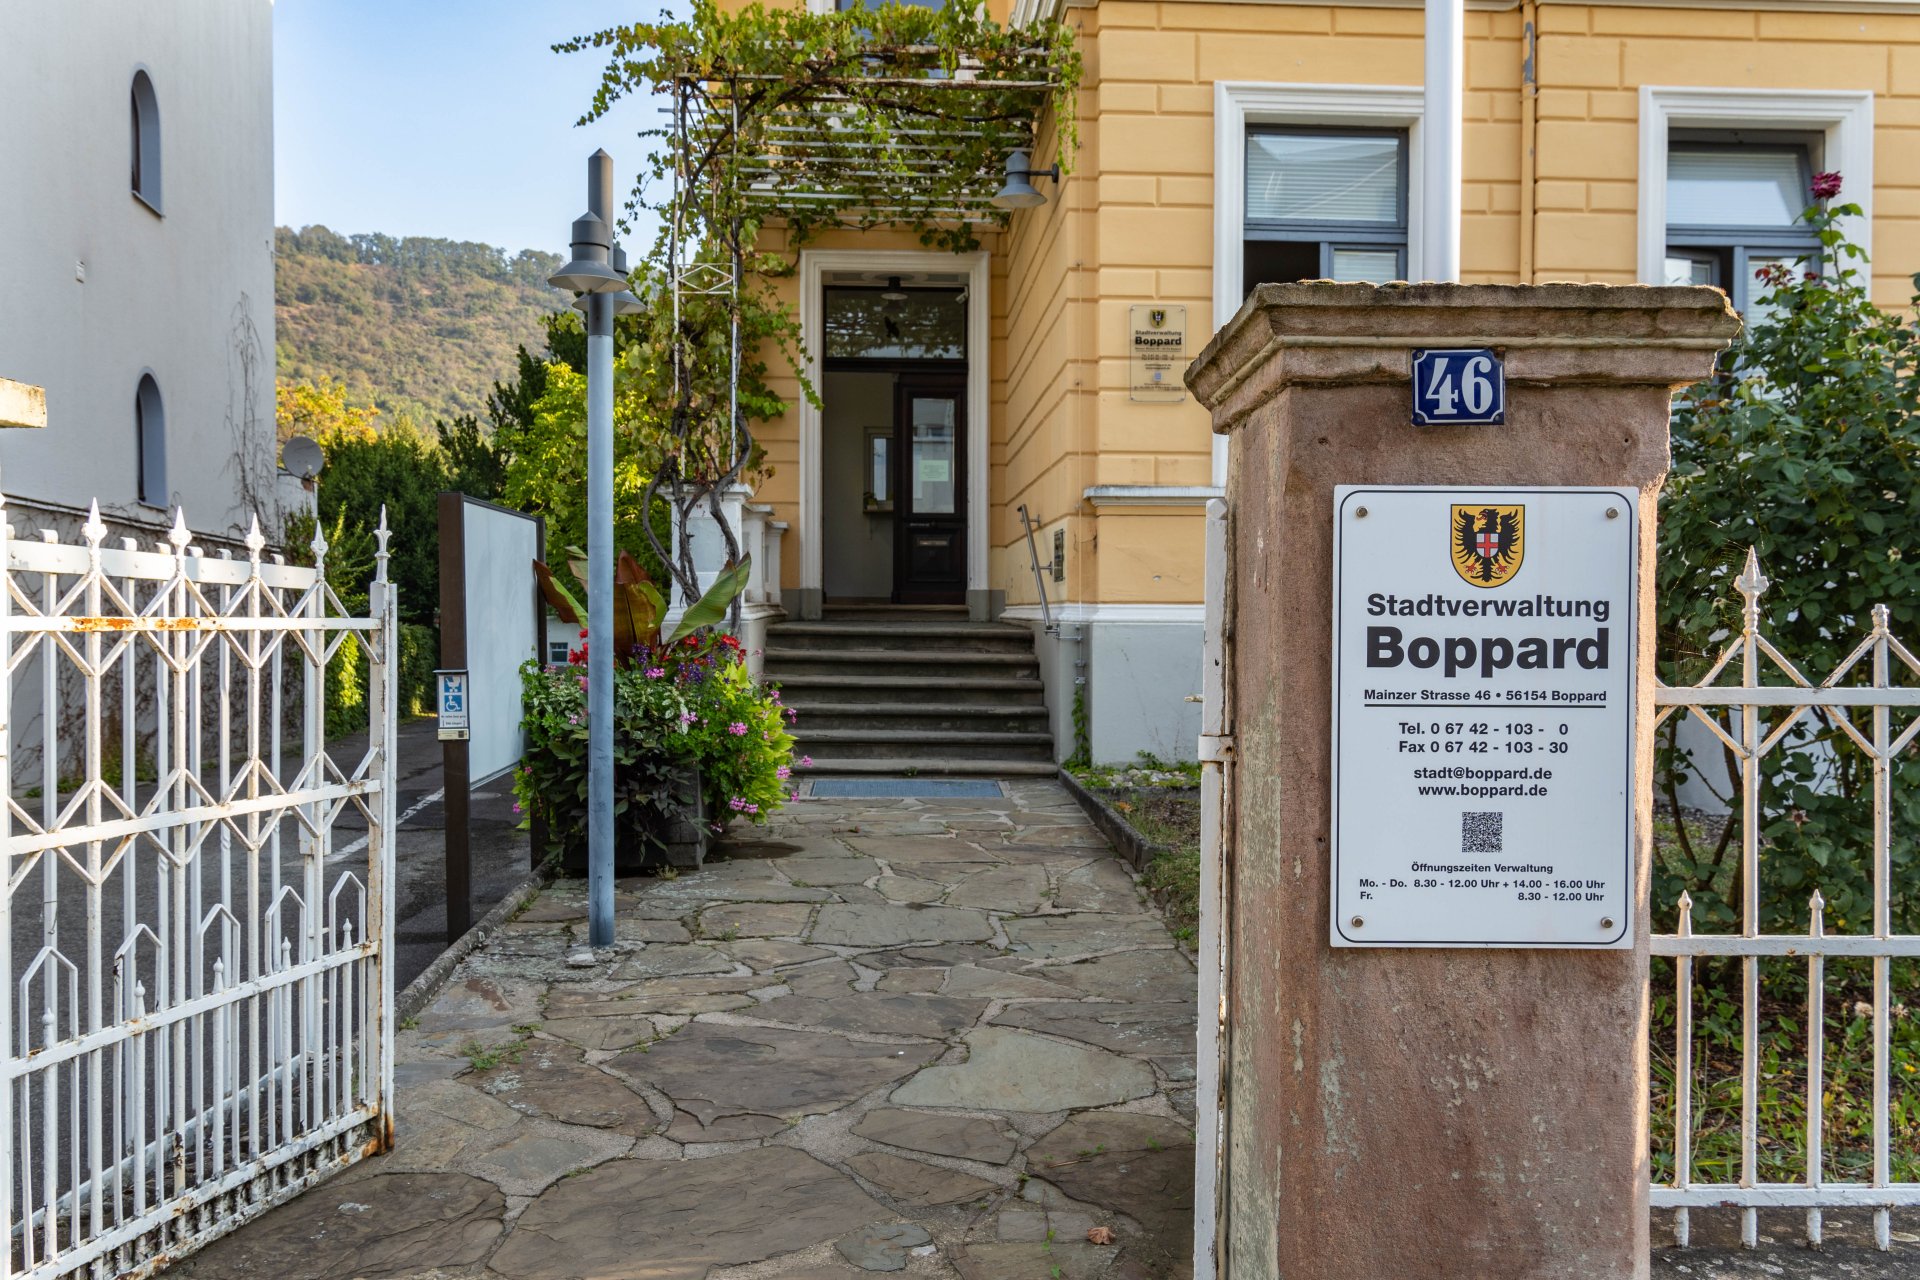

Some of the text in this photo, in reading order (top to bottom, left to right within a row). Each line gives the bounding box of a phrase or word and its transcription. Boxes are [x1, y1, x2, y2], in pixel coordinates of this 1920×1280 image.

[1135, 336, 1182, 347] Boppard
[1425, 356, 1493, 415] 46
[1367, 593, 1609, 622] Stadtverwaltung
[1367, 626, 1609, 678] Boppard
[1365, 690, 1606, 703] Mainzer Strasse 46 56154 Boppard
[1399, 723, 1425, 734] Tel.
[1431, 723, 1439, 734] 0
[1445, 723, 1463, 734] 67
[1469, 723, 1488, 734] 42
[1506, 723, 1534, 735] 103
[1559, 724, 1568, 735] 0
[1400, 741, 1425, 752] Fax
[1431, 741, 1439, 752] 0
[1445, 741, 1463, 752] 67
[1469, 742, 1487, 753] 42
[1506, 742, 1533, 753] 103
[1549, 742, 1568, 753] 30
[1414, 767, 1552, 781] stadt@boppard.de
[1418, 784, 1547, 798] www.boppard.de
[1412, 862, 1553, 874] Öffnungszeiten Verwaltung
[1360, 879, 1378, 887] Mo.
[1390, 879, 1407, 887] Do.
[1481, 880, 1499, 888] Uhr
[1513, 880, 1542, 888] 14.00
[1554, 880, 1582, 888] 16.00
[1586, 880, 1605, 888] Uhr
[1518, 892, 1541, 900] 8.30
[1553, 893, 1581, 901] 12.00
[1586, 893, 1604, 901] Uhr
